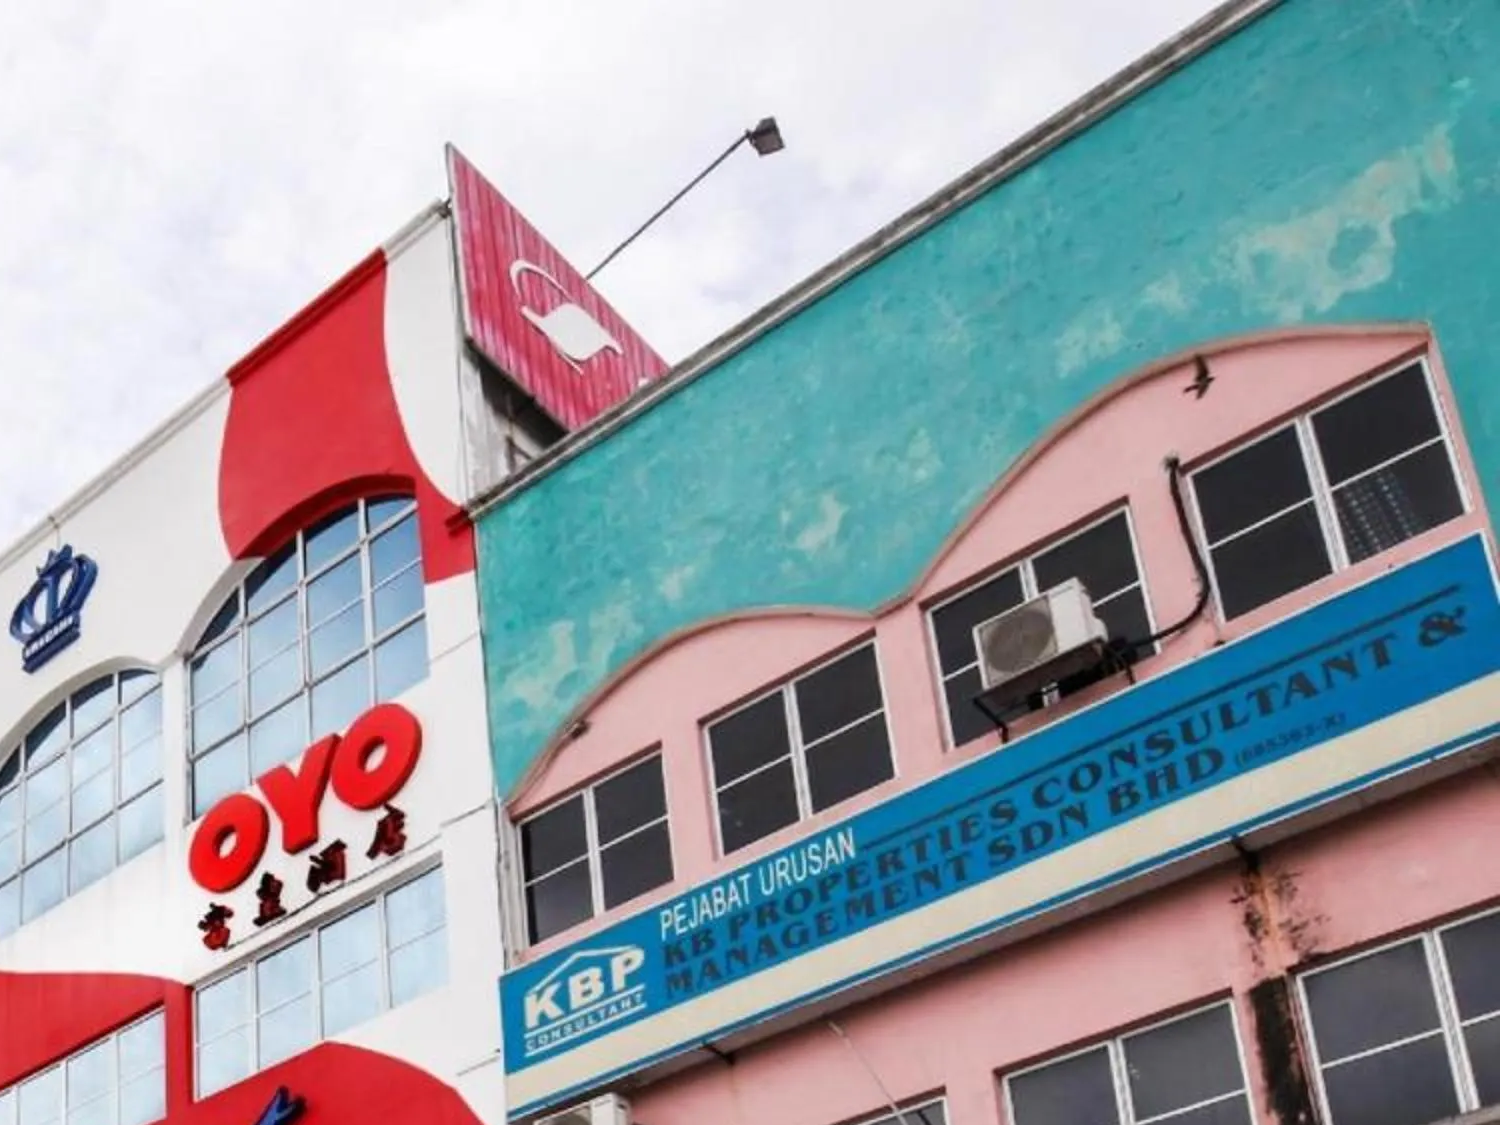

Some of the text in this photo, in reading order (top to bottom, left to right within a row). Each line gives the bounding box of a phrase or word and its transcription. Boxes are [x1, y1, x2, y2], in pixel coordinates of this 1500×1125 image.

[188, 703, 422, 893] OYO
[664, 606, 1468, 970] KB PROPERTIES CONSULTANT &
[660, 827, 857, 940] PEJABAT URUSAN
[663, 853, 977, 997] MANAGEMENT
[987, 801, 1090, 867] SDN
[1107, 748, 1226, 816] BHD
[524, 947, 645, 1029] KBP
[525, 993, 644, 1051] CONSULTANT
